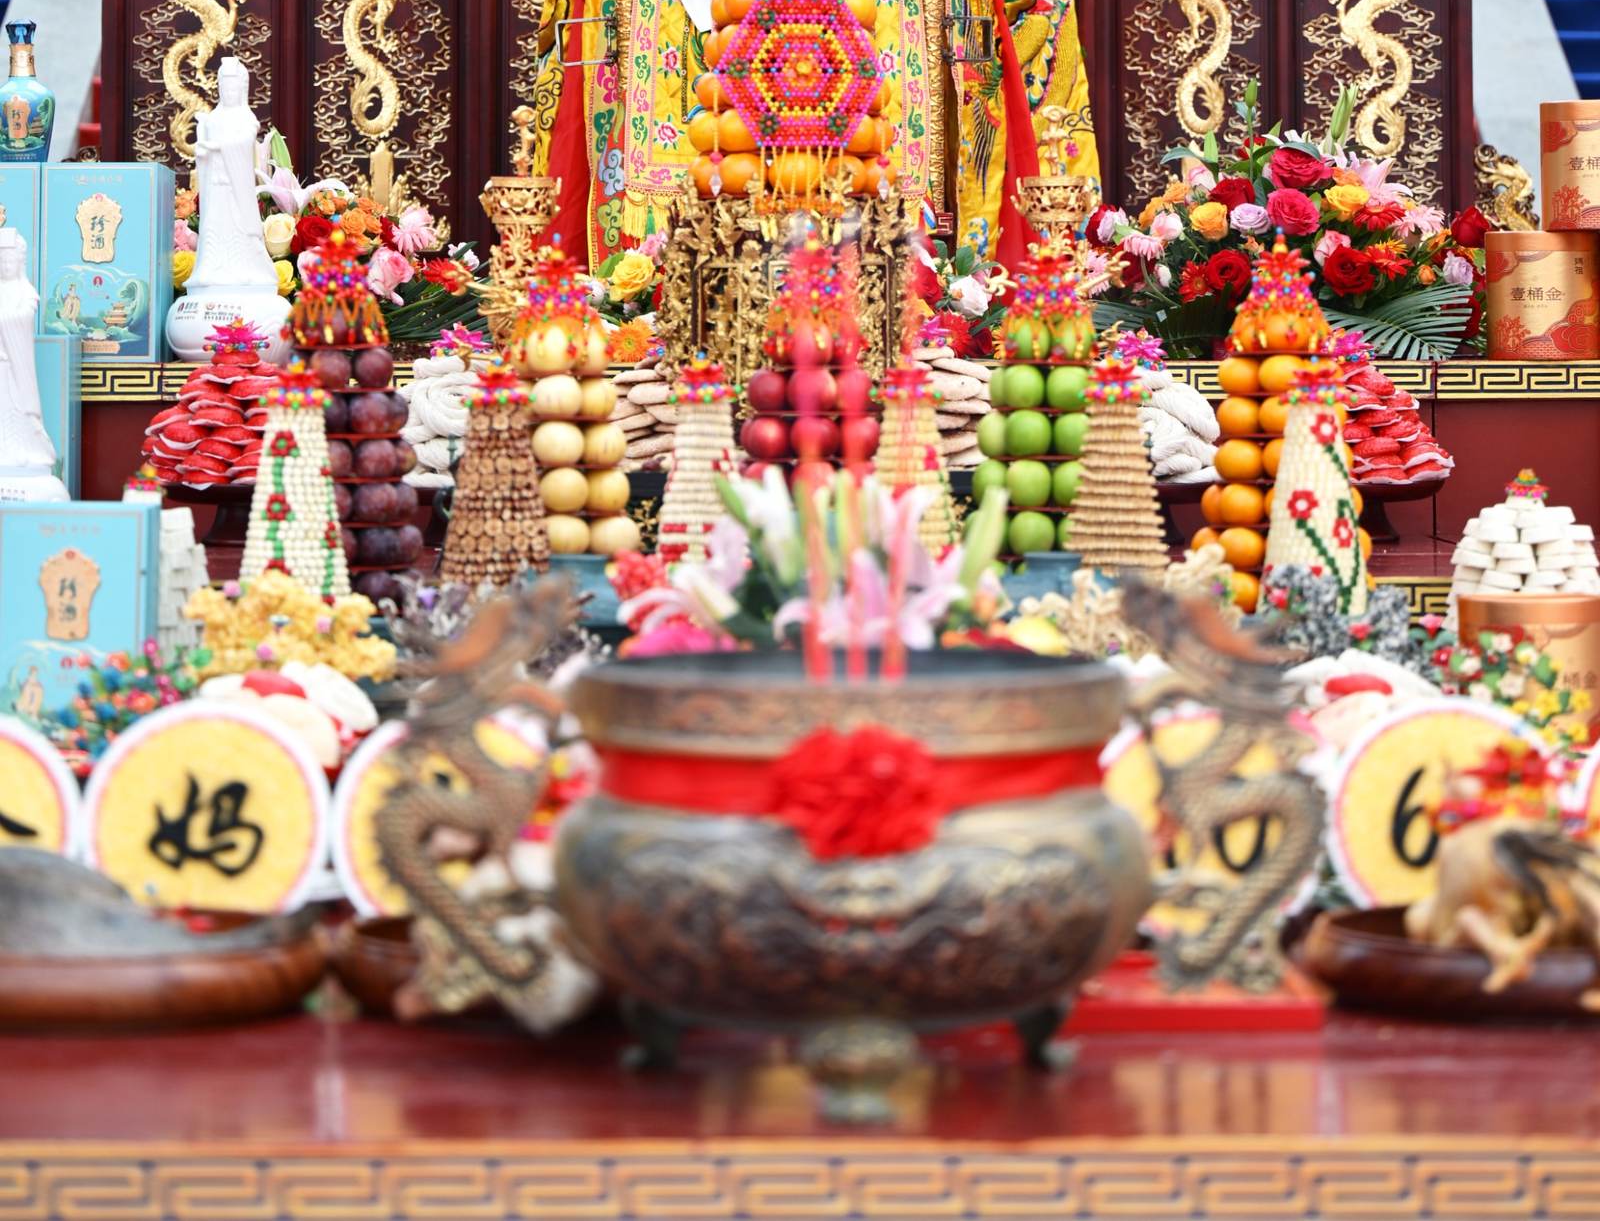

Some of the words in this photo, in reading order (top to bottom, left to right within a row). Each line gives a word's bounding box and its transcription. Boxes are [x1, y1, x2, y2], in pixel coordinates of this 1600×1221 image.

[90, 215, 109, 249] 珍酒
[1511, 286, 1562, 301] 壹桶金
